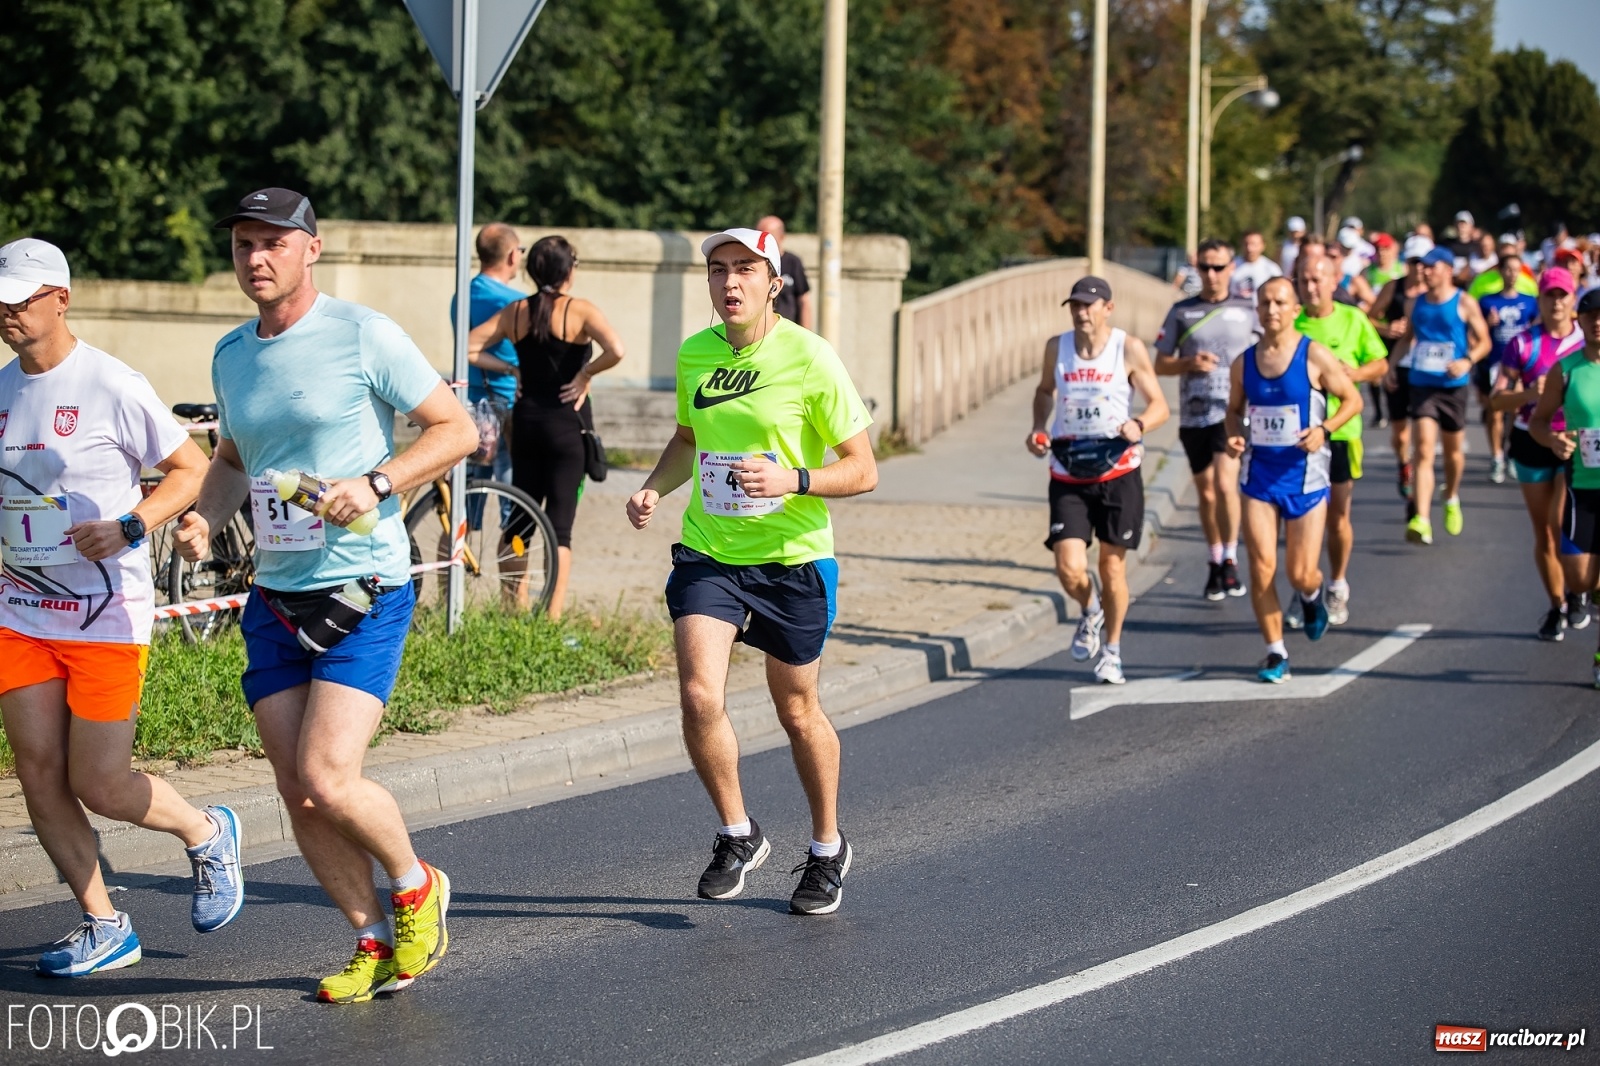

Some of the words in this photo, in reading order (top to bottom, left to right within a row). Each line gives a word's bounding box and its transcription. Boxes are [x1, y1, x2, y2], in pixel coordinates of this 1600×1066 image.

[705, 367, 761, 392] RUN
[1076, 407, 1101, 420] 364
[1263, 417, 1285, 431] 367
[268, 497, 289, 521] 51
[21, 513, 32, 543] 1
